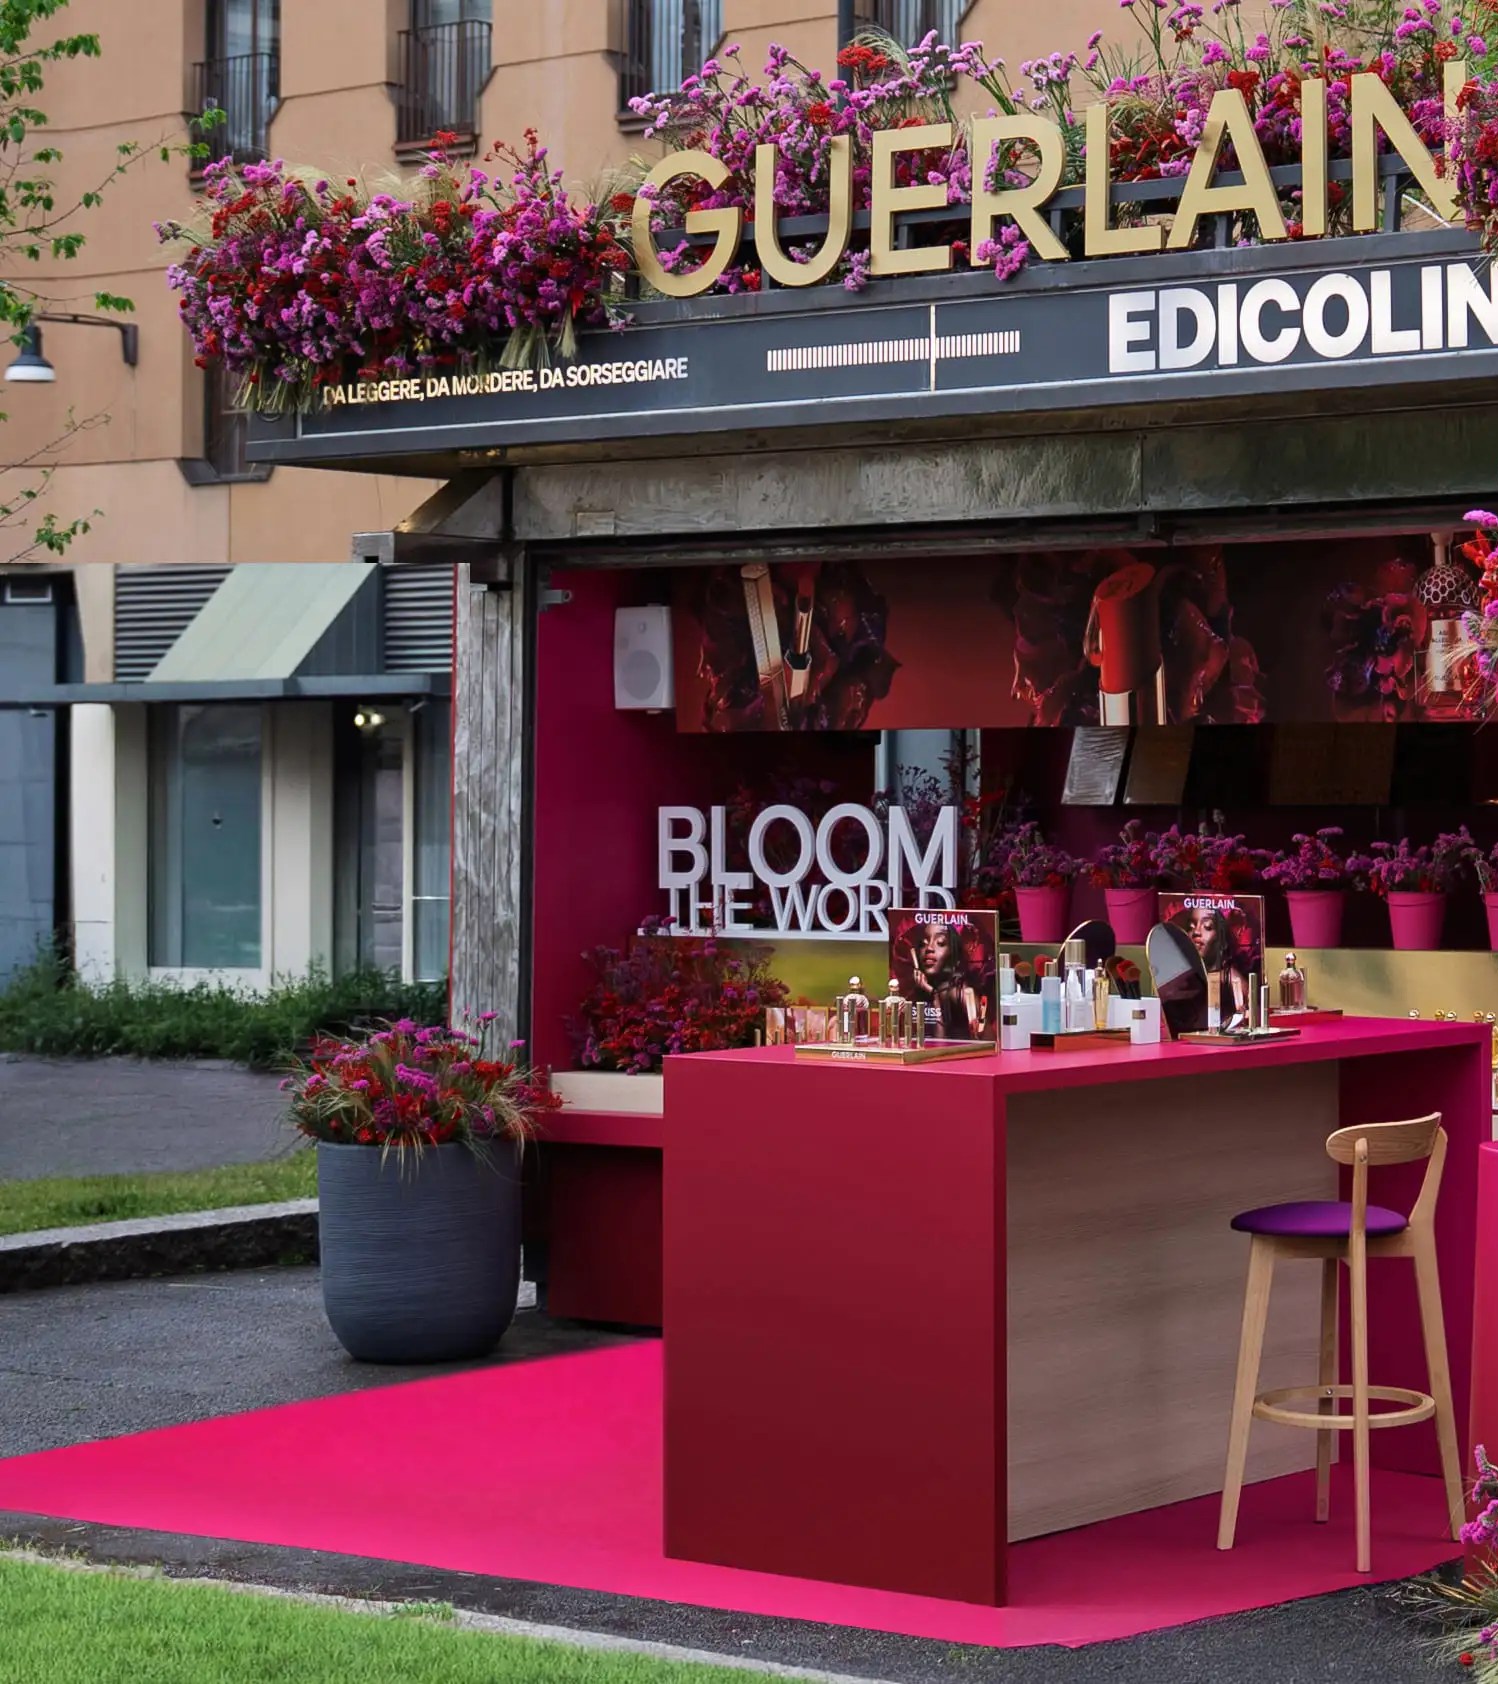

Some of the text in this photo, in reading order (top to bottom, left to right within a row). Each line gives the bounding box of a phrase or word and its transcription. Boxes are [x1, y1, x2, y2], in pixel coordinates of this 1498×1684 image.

[632, 60, 1467, 298] GUERLAIN
[323, 357, 689, 405] DA LEGGERE, DA MORDERE, DA SORSEGGIARE
[658, 803, 958, 890] BLOOM
[666, 884, 755, 937] THE
[914, 912, 969, 926] GUERLAIN
[1183, 897, 1235, 910] GUERLAIN
